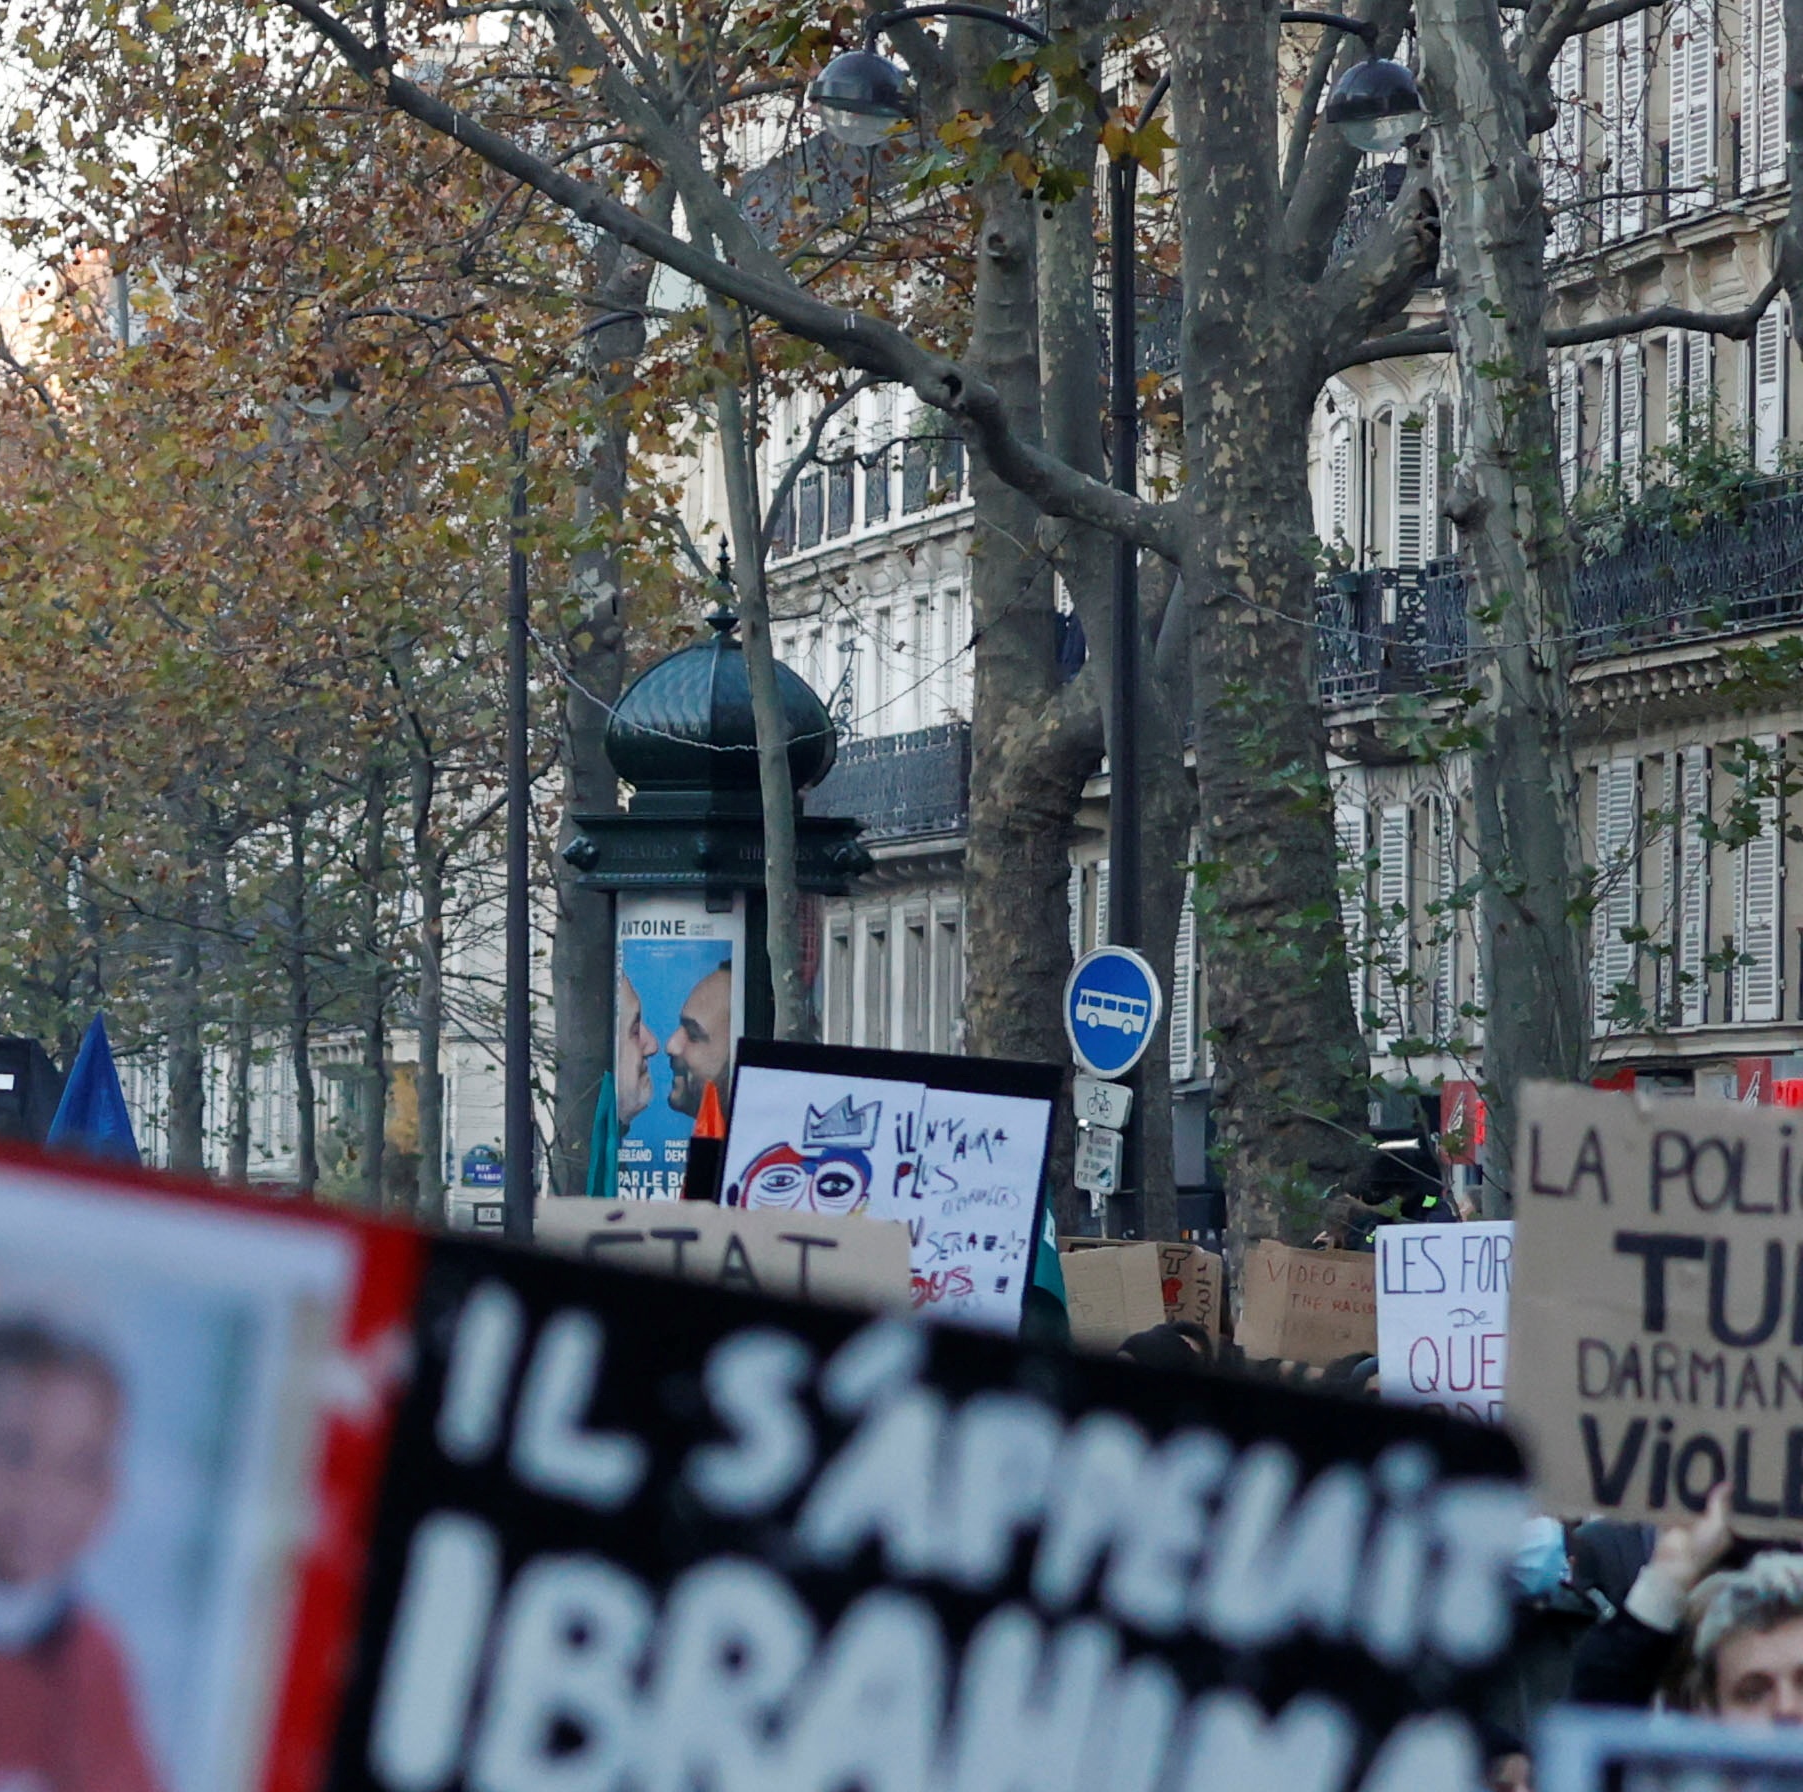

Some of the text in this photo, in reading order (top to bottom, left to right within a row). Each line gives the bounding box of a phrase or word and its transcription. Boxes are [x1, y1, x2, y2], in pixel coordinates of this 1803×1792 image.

[620, 919, 687, 936] ANTOINE
[644, 1171, 662, 1187] LE
[893, 1154, 959, 1199] PLUS
[1529, 1122, 1610, 1204] LA
[1650, 1124, 1803, 1215] POLi
[1266, 1258, 1337, 1286] VIDEO
[1381, 1234, 1513, 1295] LES FOR
[1614, 1231, 1803, 1347] TU
[438, 1280, 645, 1505] IL
[1577, 1337, 1803, 1411] DARMAN
